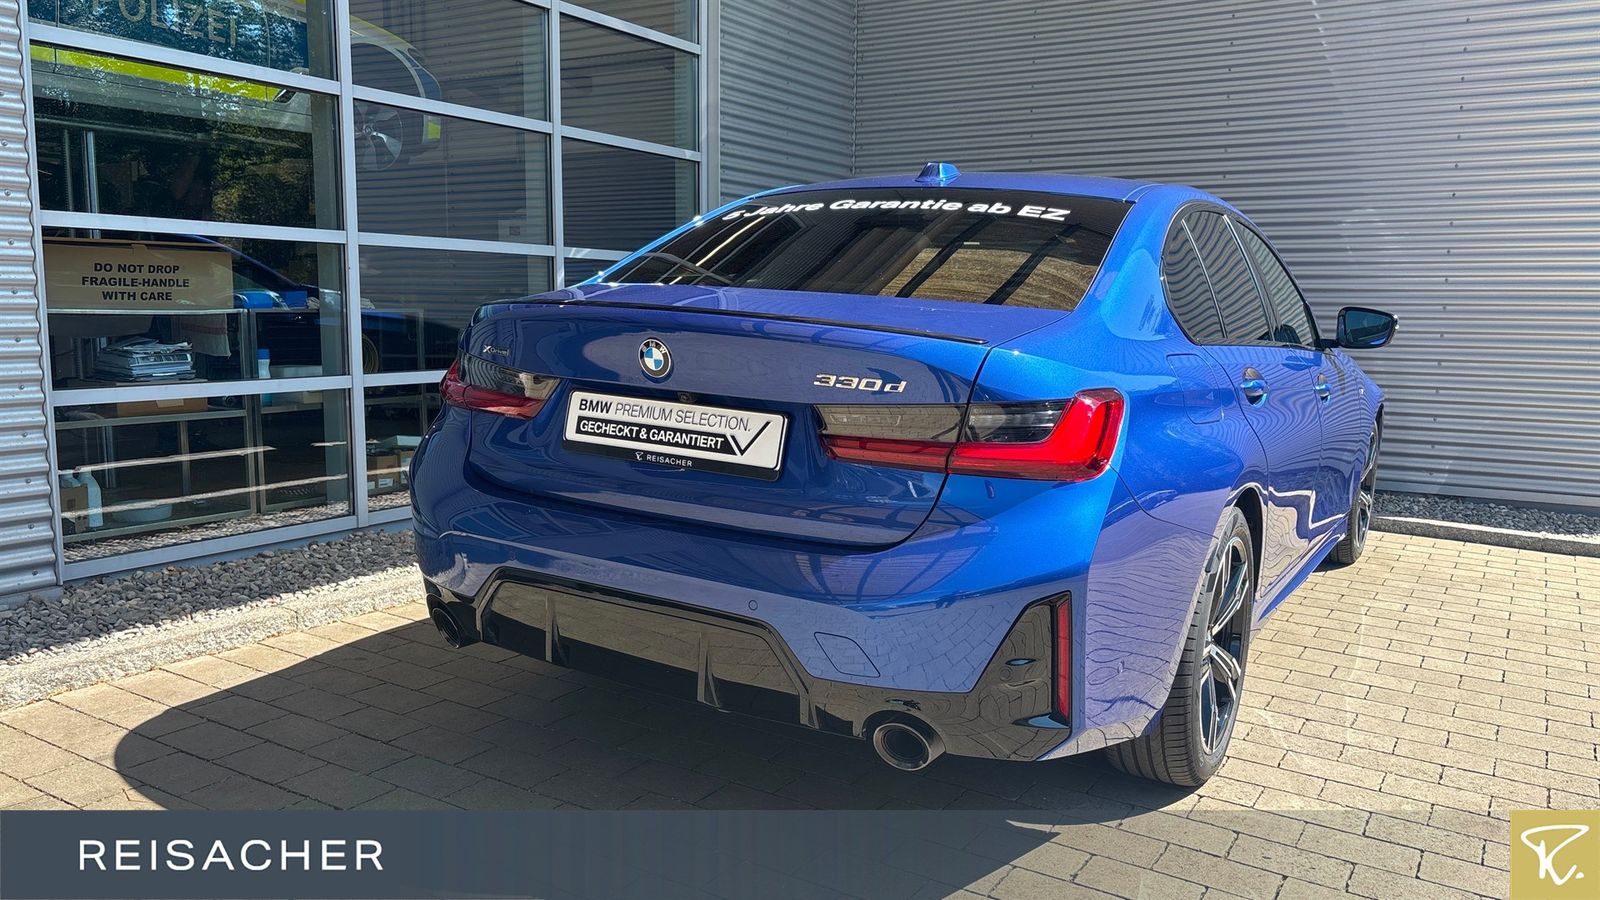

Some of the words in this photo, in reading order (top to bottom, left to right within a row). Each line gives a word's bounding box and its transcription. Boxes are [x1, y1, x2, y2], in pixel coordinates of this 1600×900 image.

[743, 203, 825, 217] Jahre
[829, 199, 963, 212] Garantie
[967, 202, 1012, 214] ab
[1017, 205, 1071, 221] EZ
[94, 262, 113, 272] DO
[117, 264, 144, 274] NOT
[148, 265, 180, 274] DROP
[81, 276, 190, 288] FRAGILE-HANDLE
[102, 291, 136, 301] WITH
[140, 292, 173, 301] CARE
[813, 373, 908, 393] 330d
[578, 398, 613, 414] BMW
[615, 402, 673, 423] PREMIUM
[580, 419, 638, 439] GECHECKT
[639, 428, 648, 440] &
[649, 429, 725, 450] GARANTIERT
[646, 454, 693, 467] REISACHER
